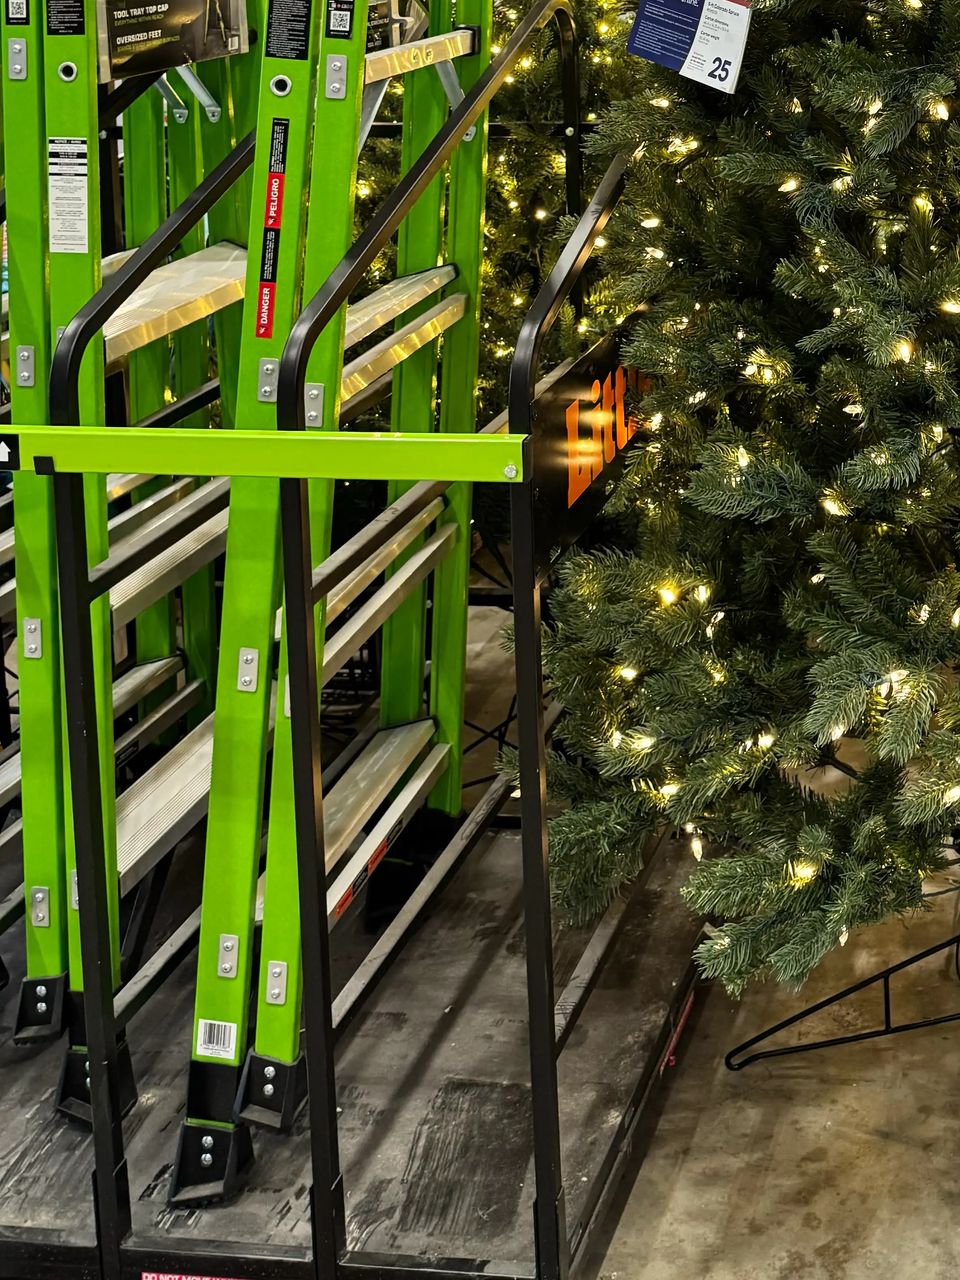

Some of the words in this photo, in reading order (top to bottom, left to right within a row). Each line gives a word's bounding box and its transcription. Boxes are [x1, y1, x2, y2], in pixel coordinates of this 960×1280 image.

[113, 10, 130, 19] TOOL
[130, 7, 145, 17] TRAY
[145, 5, 157, 14] TOP
[157, 3, 169, 12] CAP
[116, 32, 148, 45] OVERSIZED
[148, 29, 162, 39] FEET
[708, 56, 732, 82] 25
[269, 178, 280, 217] PELIGRO
[261, 287, 270, 324] DANGER
[565, 365, 640, 509] Litt
